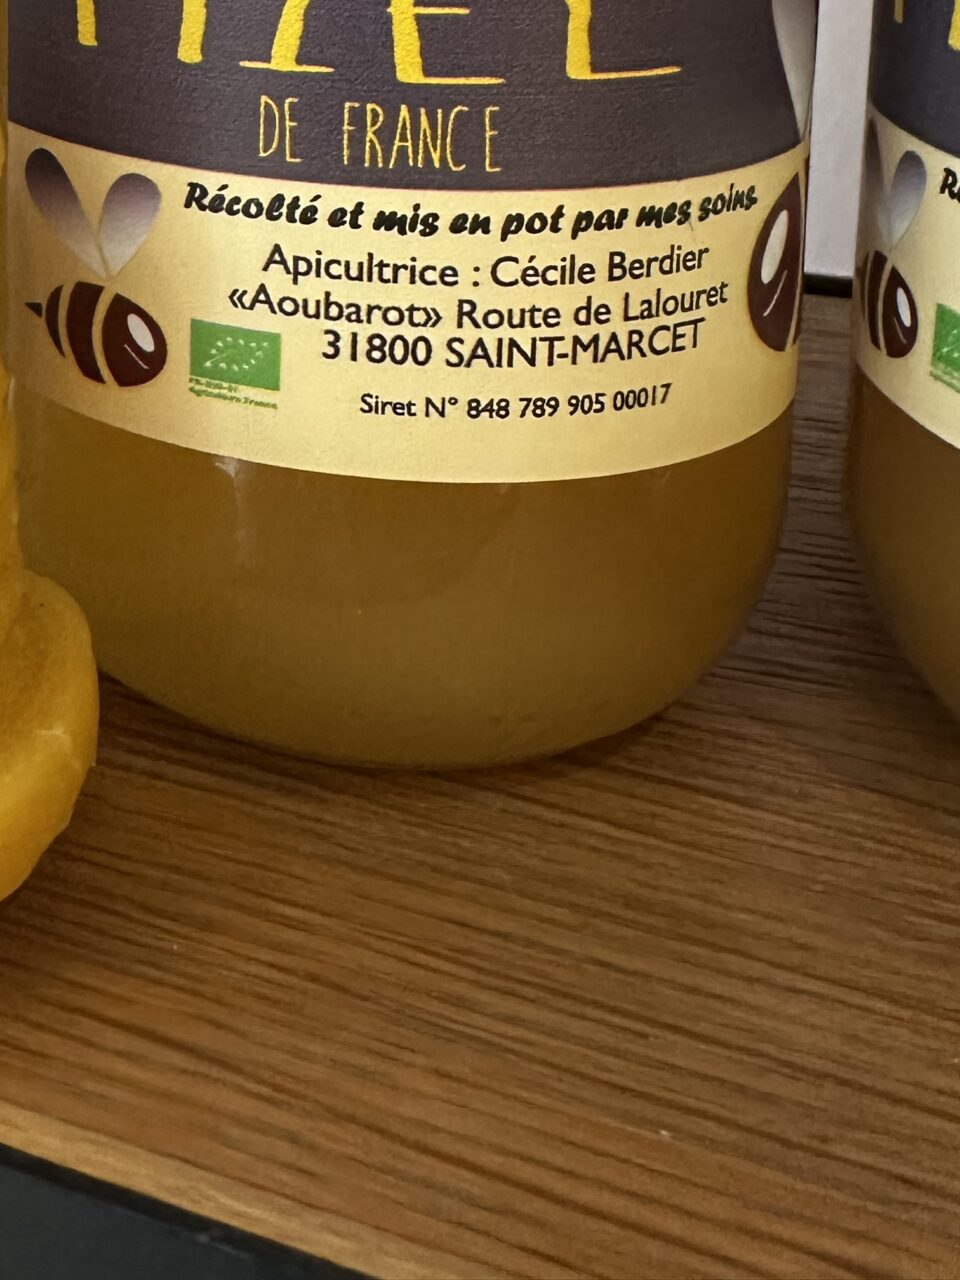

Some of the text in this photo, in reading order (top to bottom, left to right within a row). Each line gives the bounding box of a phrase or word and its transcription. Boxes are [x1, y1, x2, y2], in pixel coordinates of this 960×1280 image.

[258, 95, 502, 172] DE FRANCE
[183, 182, 758, 242] Récolté et mis en pot par mes soins
[261, 243, 709, 287] Apicultrice : Cécile Berdier
[228, 281, 728, 330] «Aoubarot» Route de Lalouret
[321, 317, 706, 369] 31800 SAINT-MARCET
[359, 383, 673, 419] Siret N° 848 789 905 00017
